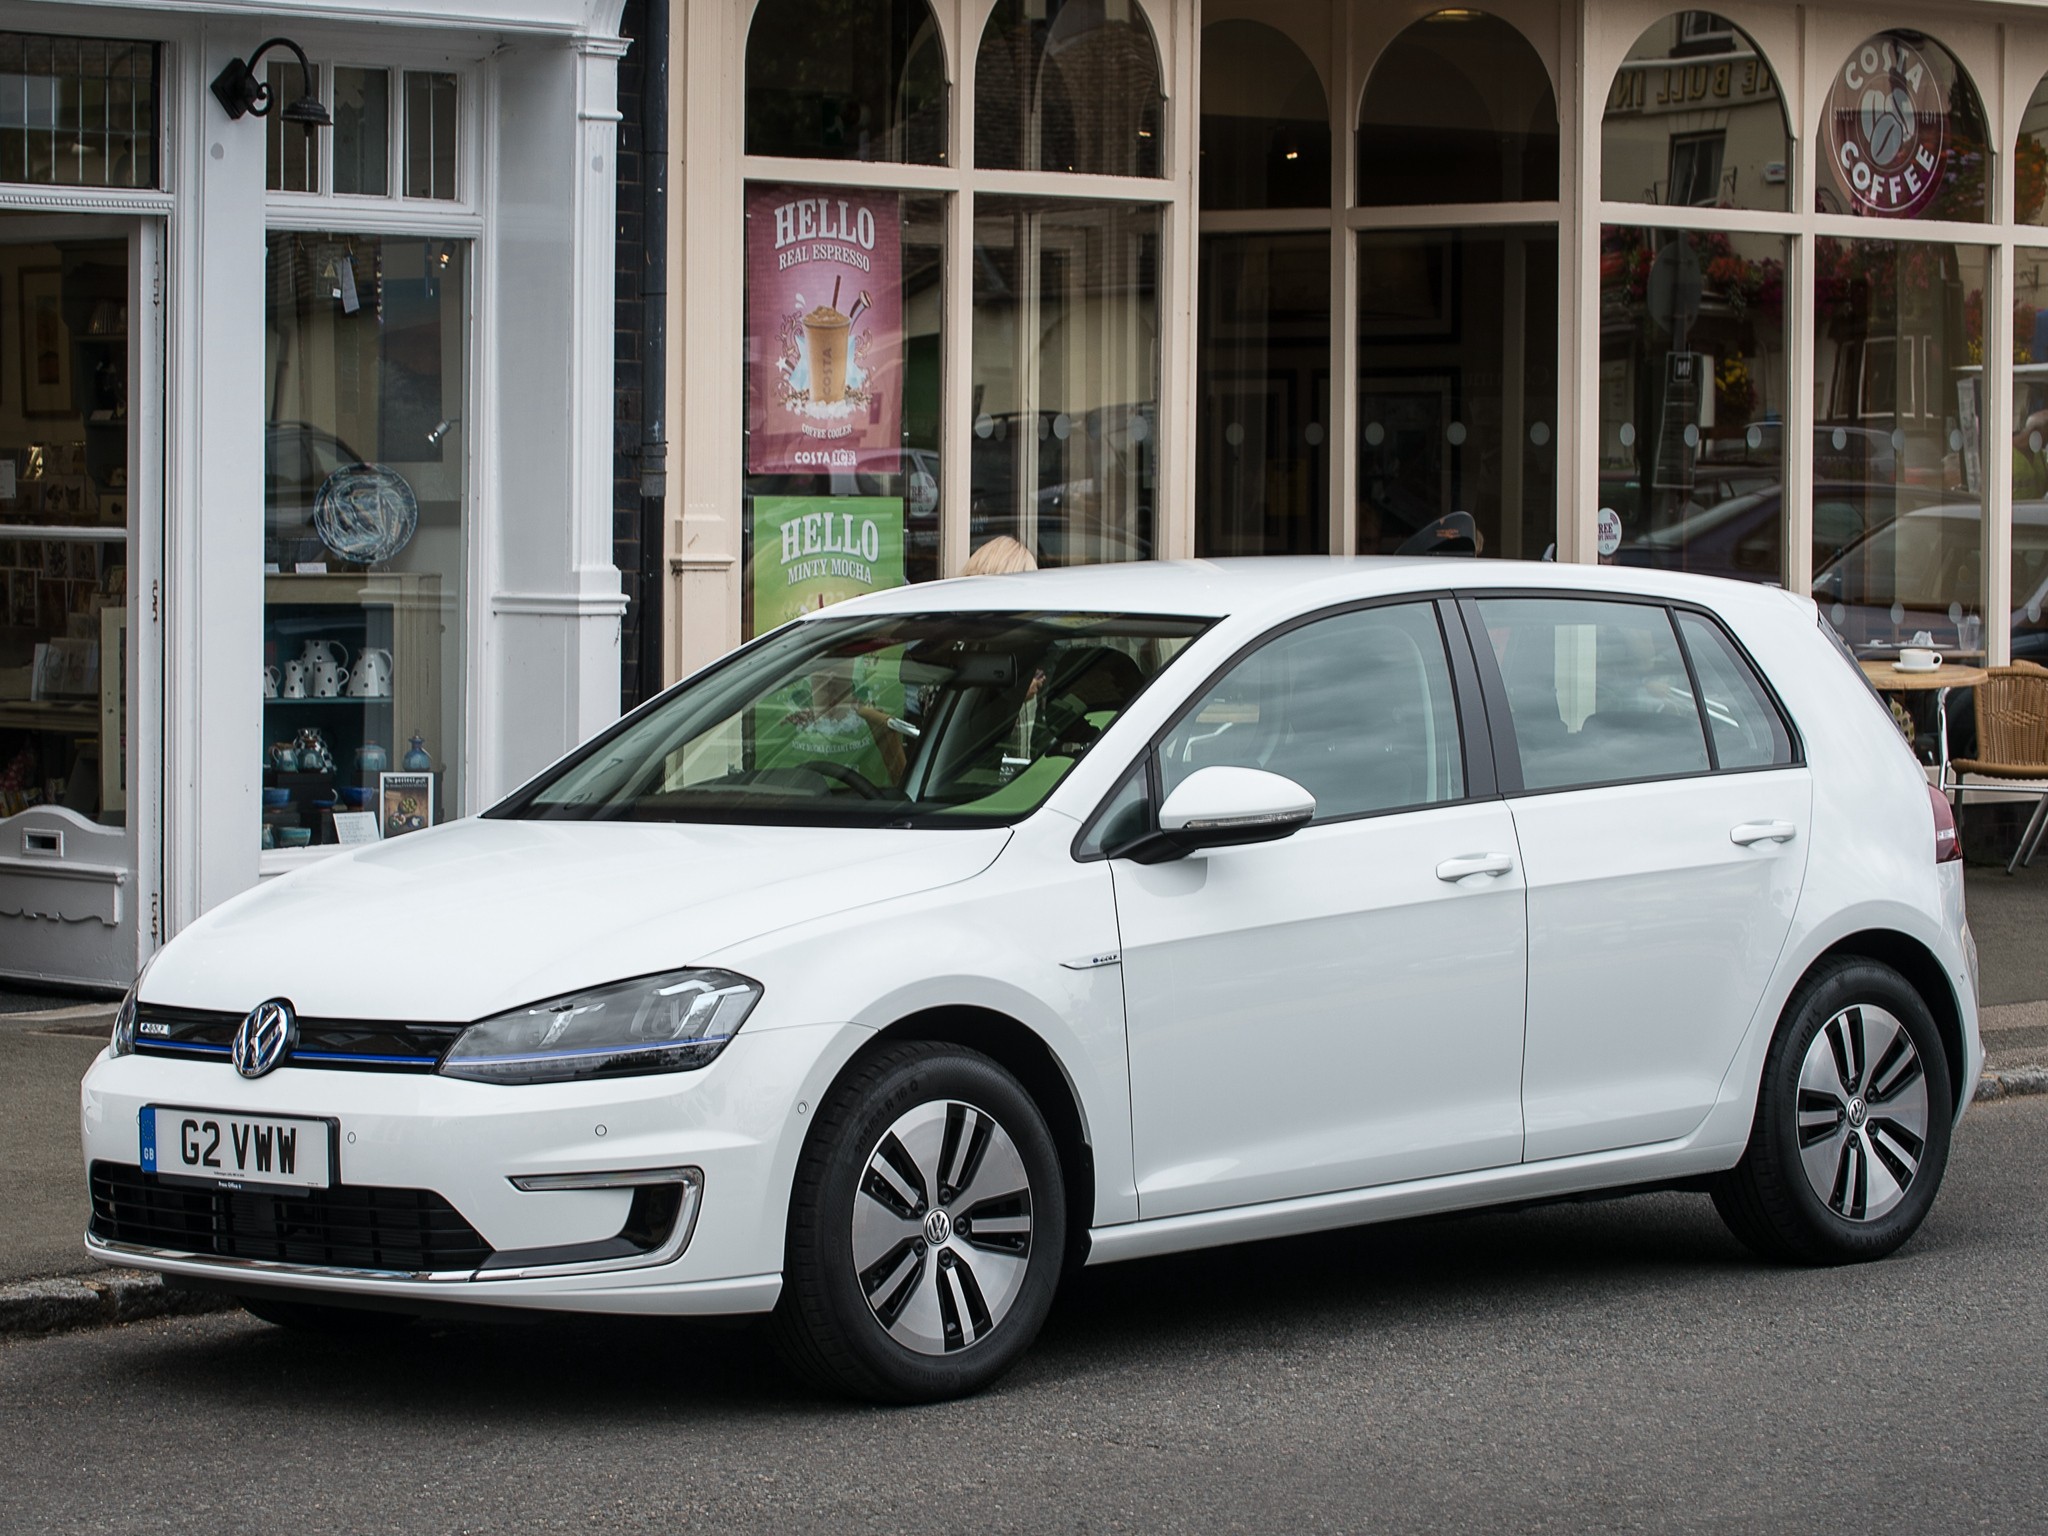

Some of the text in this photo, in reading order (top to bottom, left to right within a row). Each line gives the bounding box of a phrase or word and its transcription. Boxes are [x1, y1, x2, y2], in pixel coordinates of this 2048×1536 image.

[1845, 41, 1923, 94] COSTA
[1921, 110, 1937, 124] 1971
[1840, 141, 1935, 204] COFFEE
[774, 198, 875, 250] HELLO
[779, 244, 870, 272] REAL ESPRESSO
[801, 423, 852, 439] COFFEE COOLER
[794, 451, 830, 465] COSTA
[780, 512, 879, 565] HELLO
[787, 558, 872, 586] MINTY MOCHA
[143, 1147, 154, 1161] GB
[181, 1118, 297, 1175] G2 VWW
